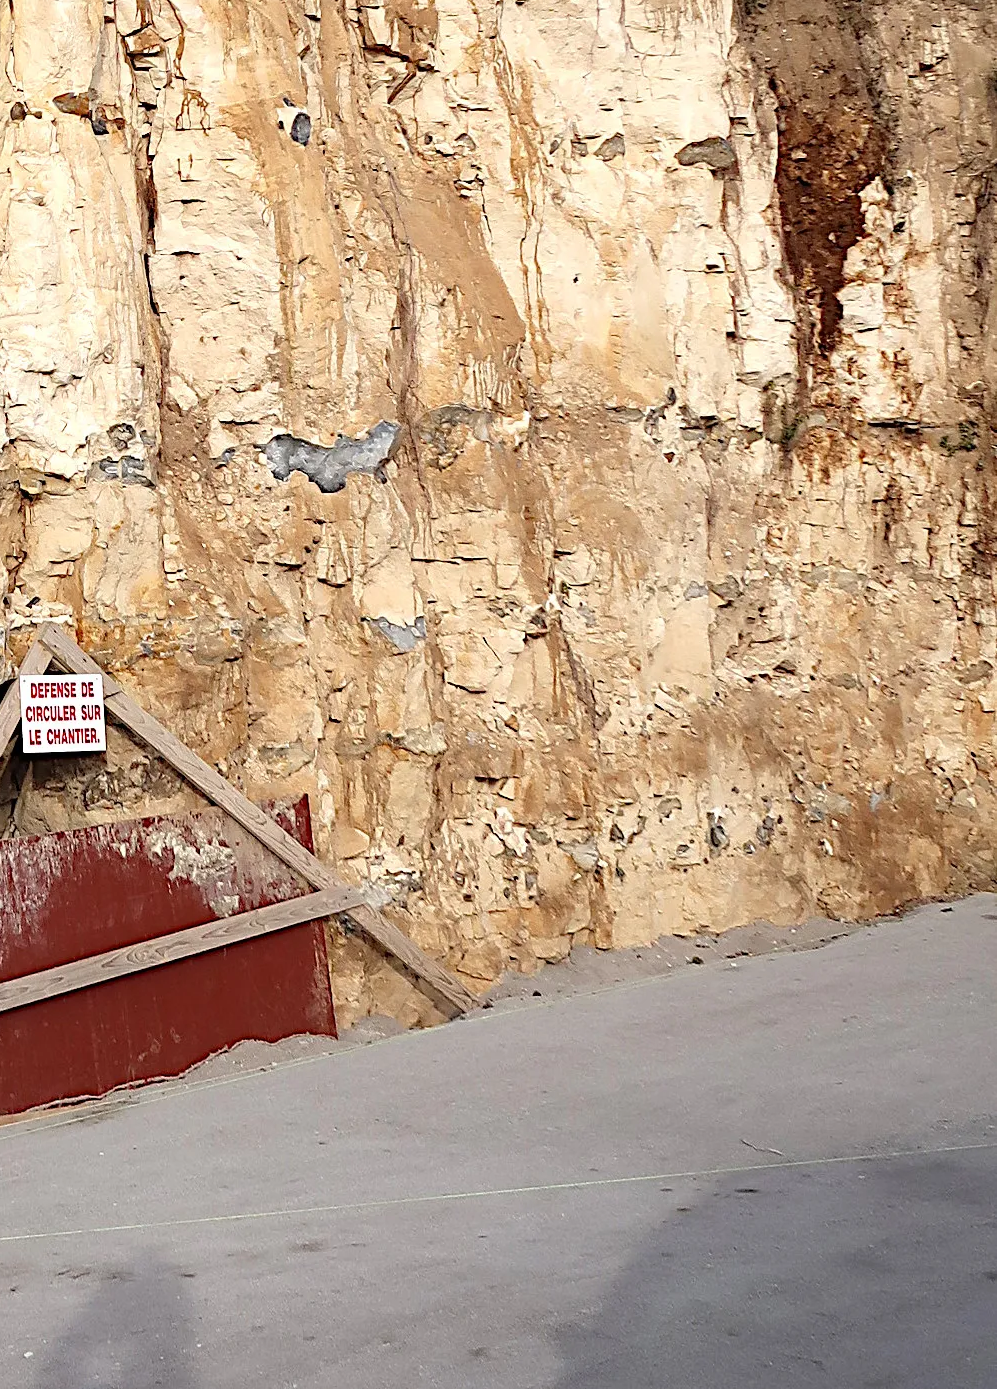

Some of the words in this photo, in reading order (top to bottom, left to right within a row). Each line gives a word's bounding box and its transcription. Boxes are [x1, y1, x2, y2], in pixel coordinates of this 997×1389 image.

[30, 682, 76, 698] DEFENSE
[81, 682, 94, 697] DE
[26, 705, 76, 722] CIRCULER
[81, 704, 101, 720] SUR
[29, 729, 41, 745] LE
[46, 728, 100, 745] CHANTIER.
